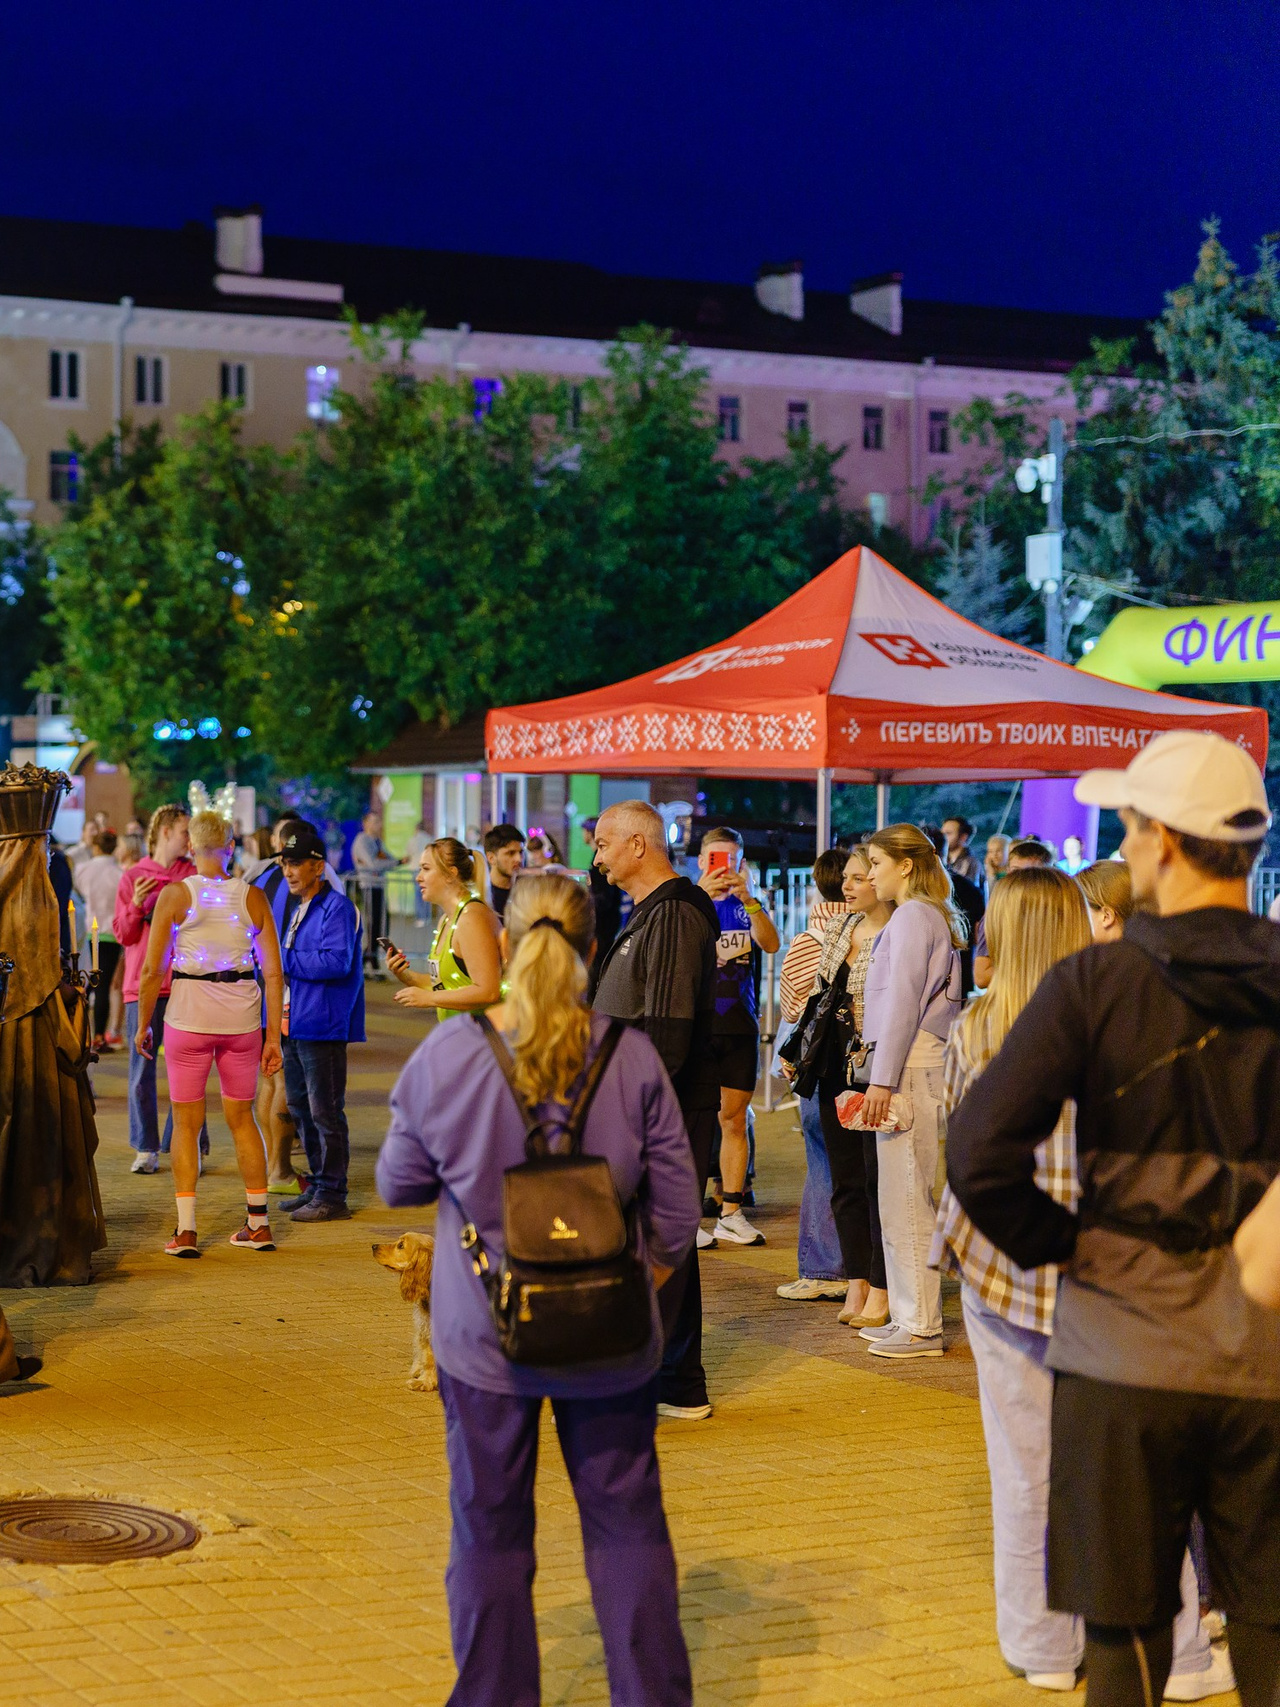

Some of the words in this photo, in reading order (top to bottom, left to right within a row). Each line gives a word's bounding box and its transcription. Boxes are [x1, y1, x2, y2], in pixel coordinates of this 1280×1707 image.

[879, 720, 993, 744] ПЕРЕВИТЬ
[996, 722, 1067, 745] ТВОИХ
[1071, 724, 1170, 749] ВПЕЧАТ
[720, 932, 746, 949] 547
